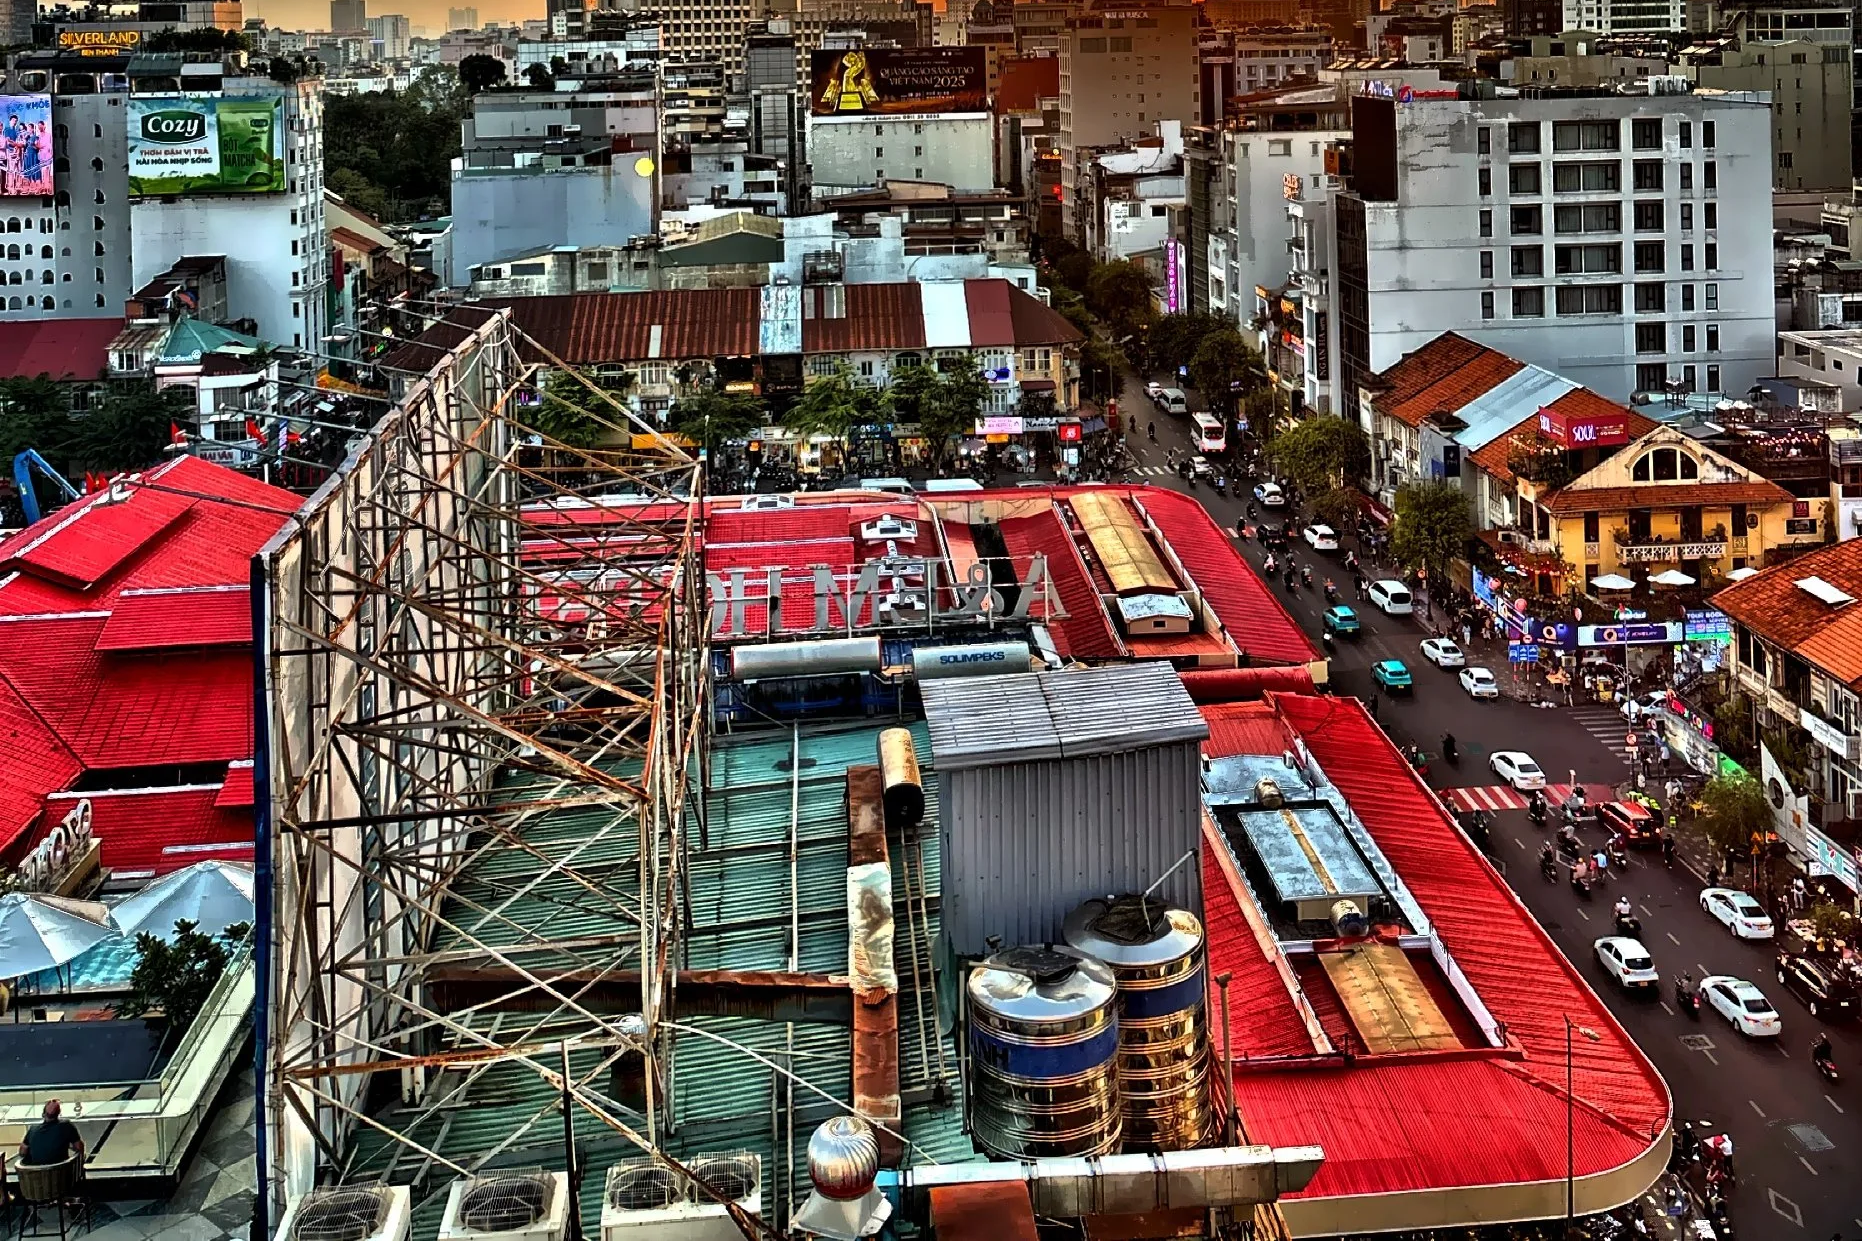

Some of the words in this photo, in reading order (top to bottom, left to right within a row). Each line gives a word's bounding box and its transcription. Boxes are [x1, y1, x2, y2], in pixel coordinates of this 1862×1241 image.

[59, 31, 139, 45] SILVERLAND
[911, 77, 933, 85] NAM
[934, 75, 966, 87] 2025
[147, 116, 199, 137] Cozy
[223, 154, 256, 166] MATCHA
[939, 651, 1006, 664] SOLIMPEKS
